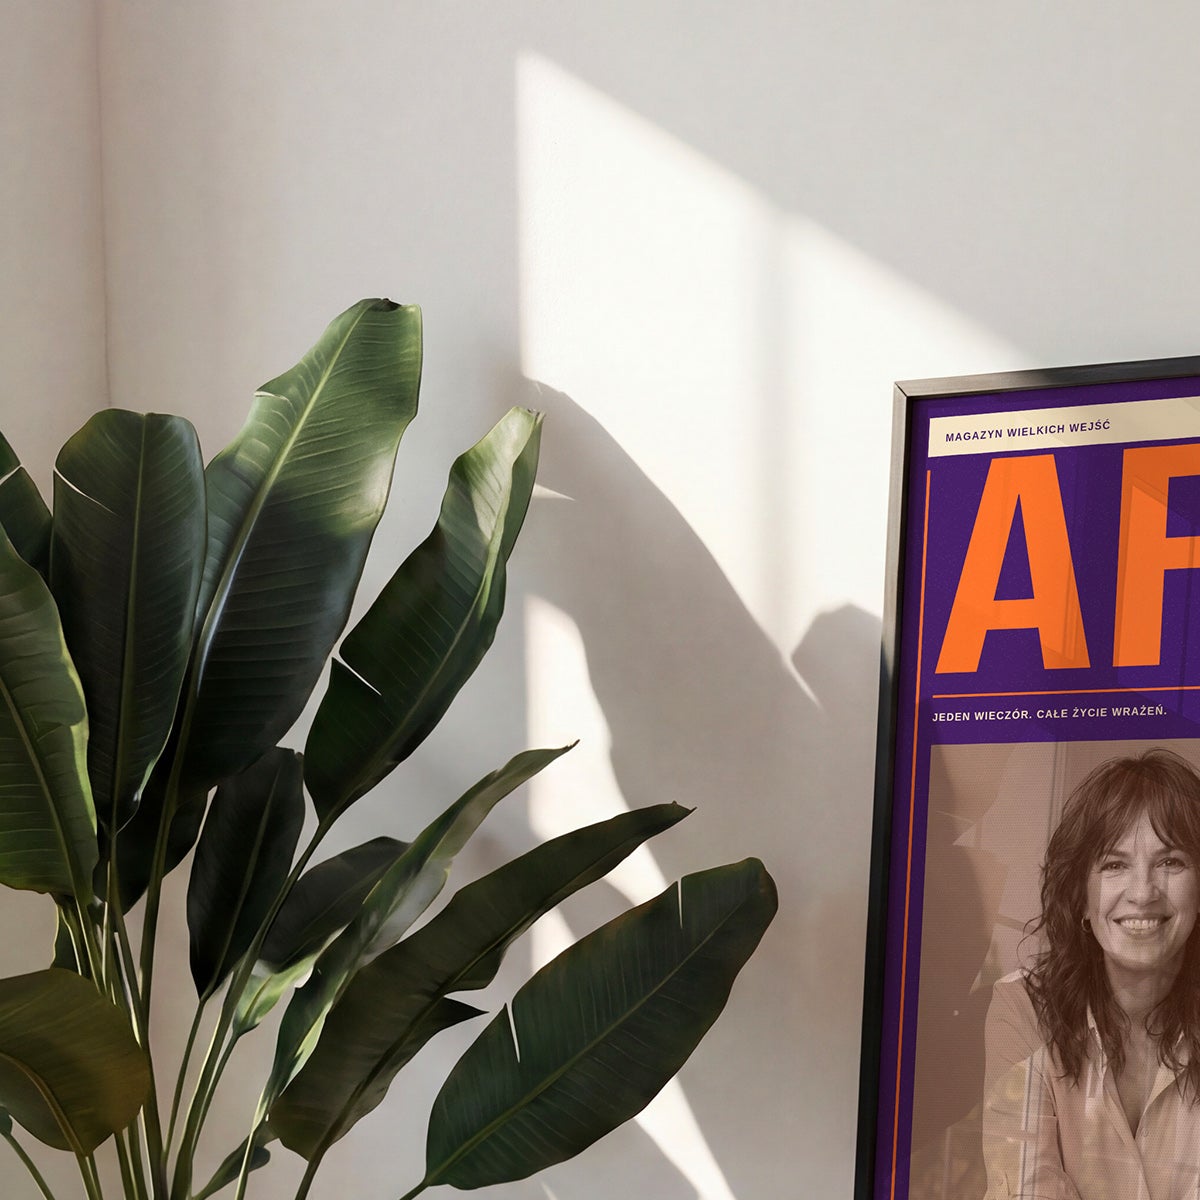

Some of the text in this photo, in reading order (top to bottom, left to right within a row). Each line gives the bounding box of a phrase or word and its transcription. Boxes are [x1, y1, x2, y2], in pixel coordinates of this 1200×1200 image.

[946, 418, 1110, 442] MAGAZYN WIELKICH WEJŚĆ
[932, 704, 1167, 722] JEDEN WIECZÓR. CAŁE ŻYCIE WRAŻEŃ.
